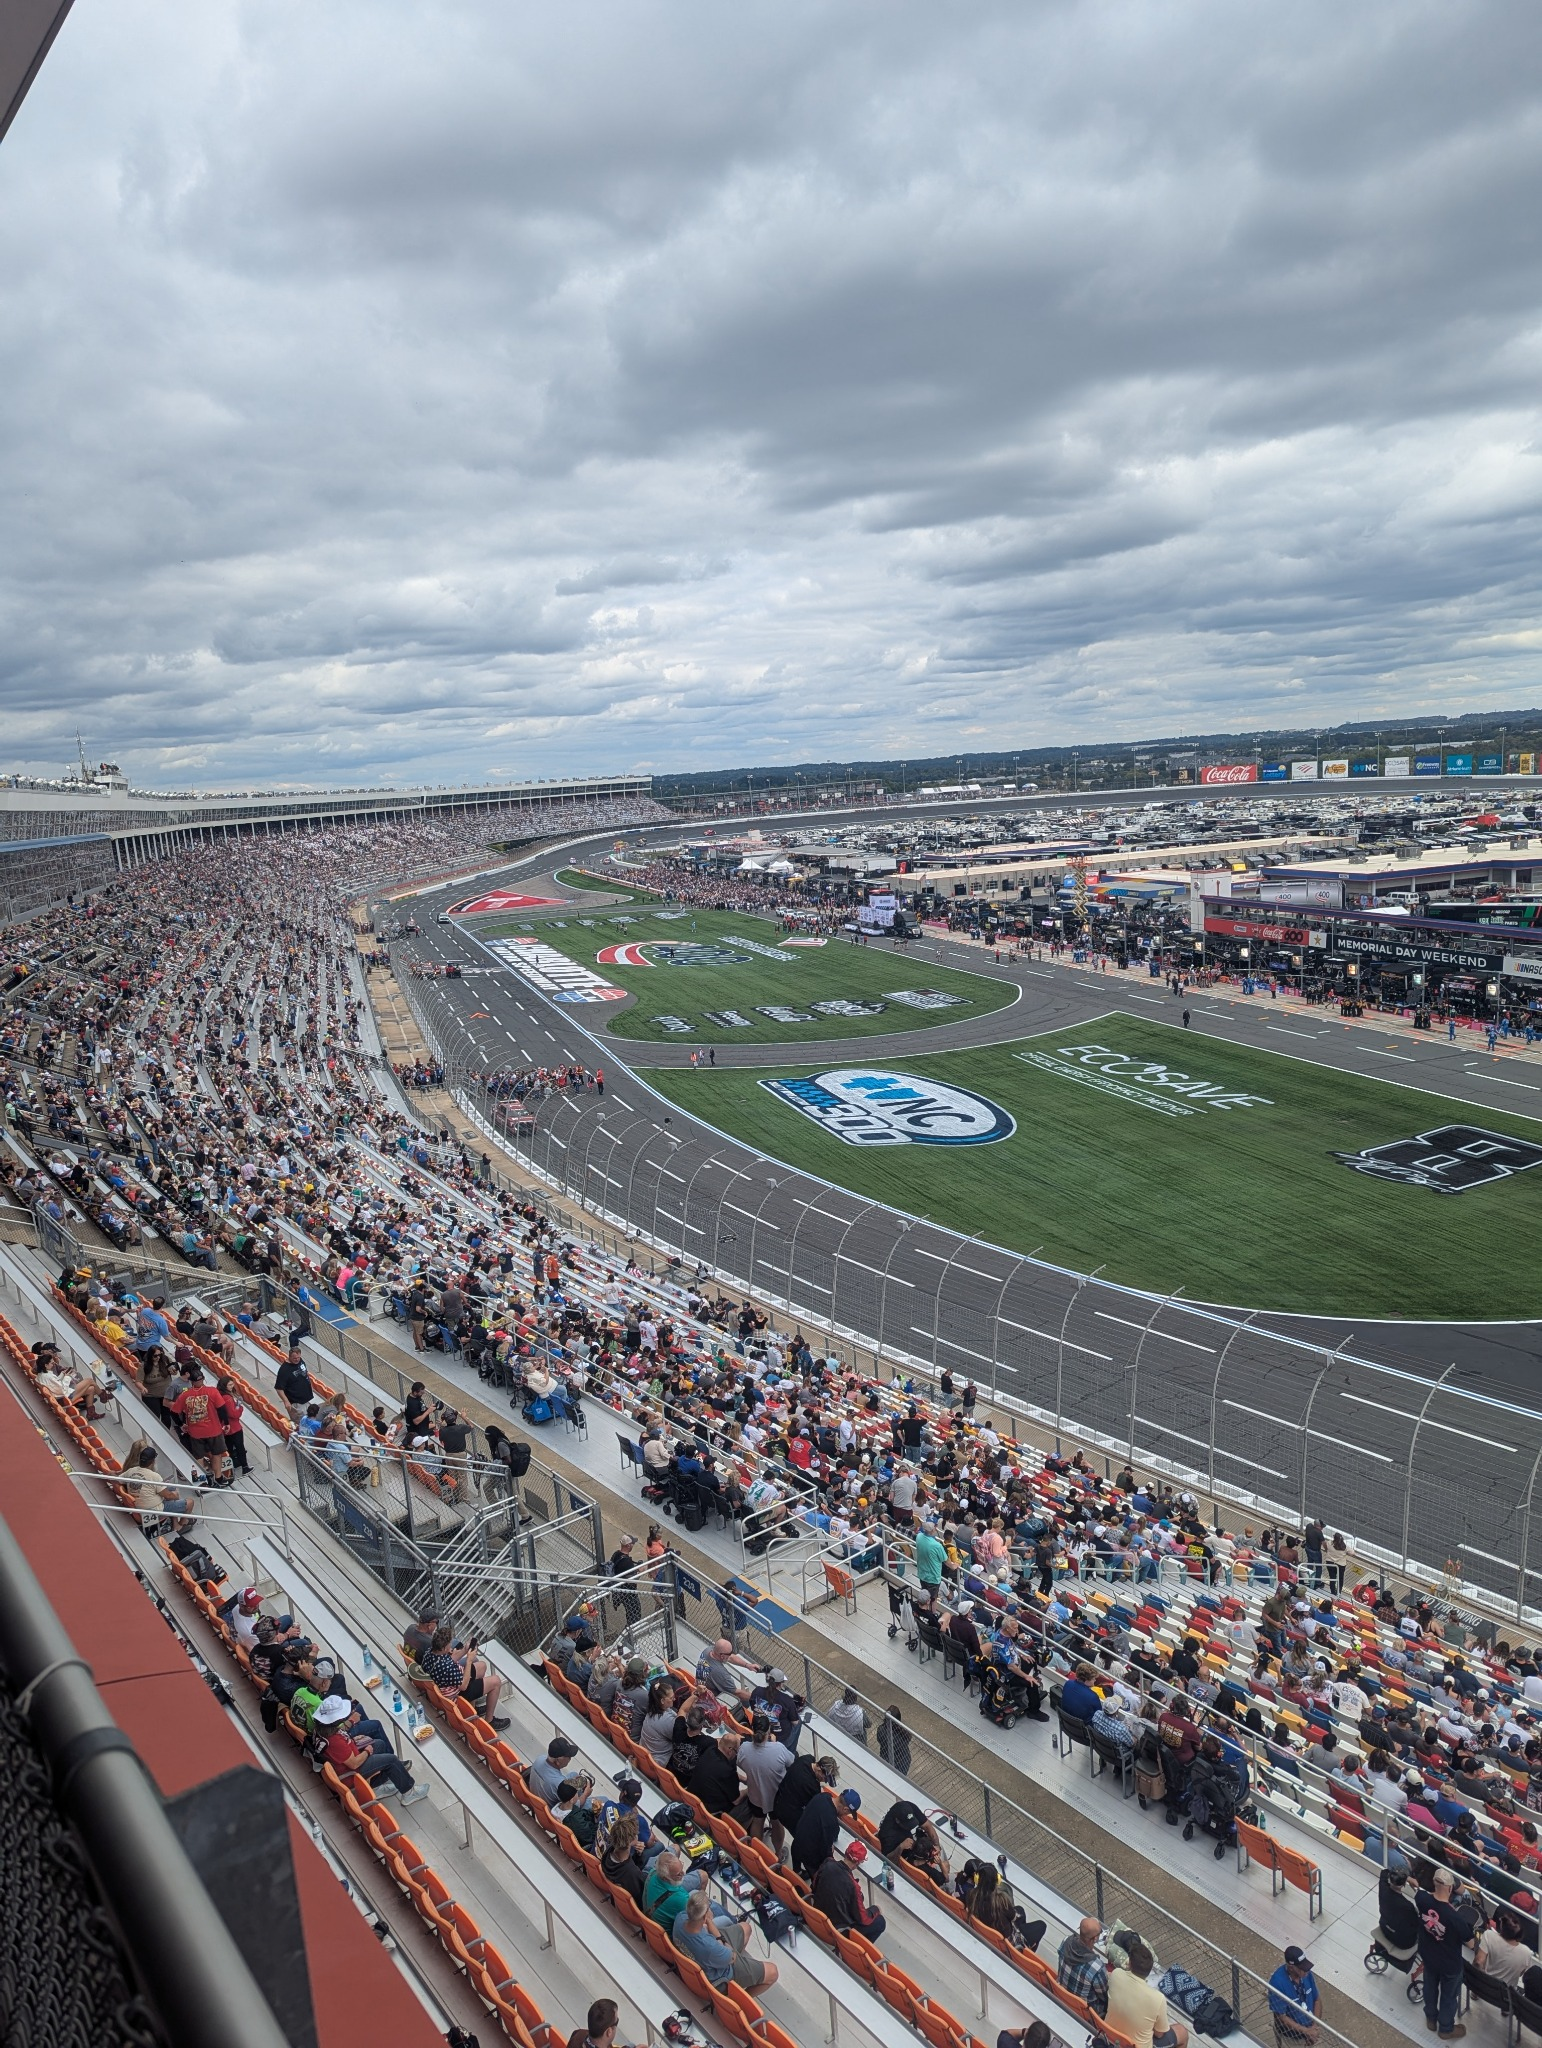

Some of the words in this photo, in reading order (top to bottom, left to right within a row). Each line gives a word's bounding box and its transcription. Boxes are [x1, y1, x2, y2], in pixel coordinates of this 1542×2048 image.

[1206, 766, 1252, 782] Coca-Cola
[1365, 764, 1377, 772] NC
[1284, 930, 1304, 943] 600
[1338, 938, 1392, 955] MEMORIAL
[1396, 947, 1417, 958] DAY
[1422, 950, 1487, 968] WEEKEND
[1057, 1045, 1275, 1110] ECOSAVE
[878, 1098, 976, 1128] NC
[803, 1104, 913, 1145] 300
[221, 1459, 232, 1468] 32
[748, 1482, 766, 1500] 34
[143, 1514, 158, 1524] 34
[1420, 1595, 1435, 1606] NO
